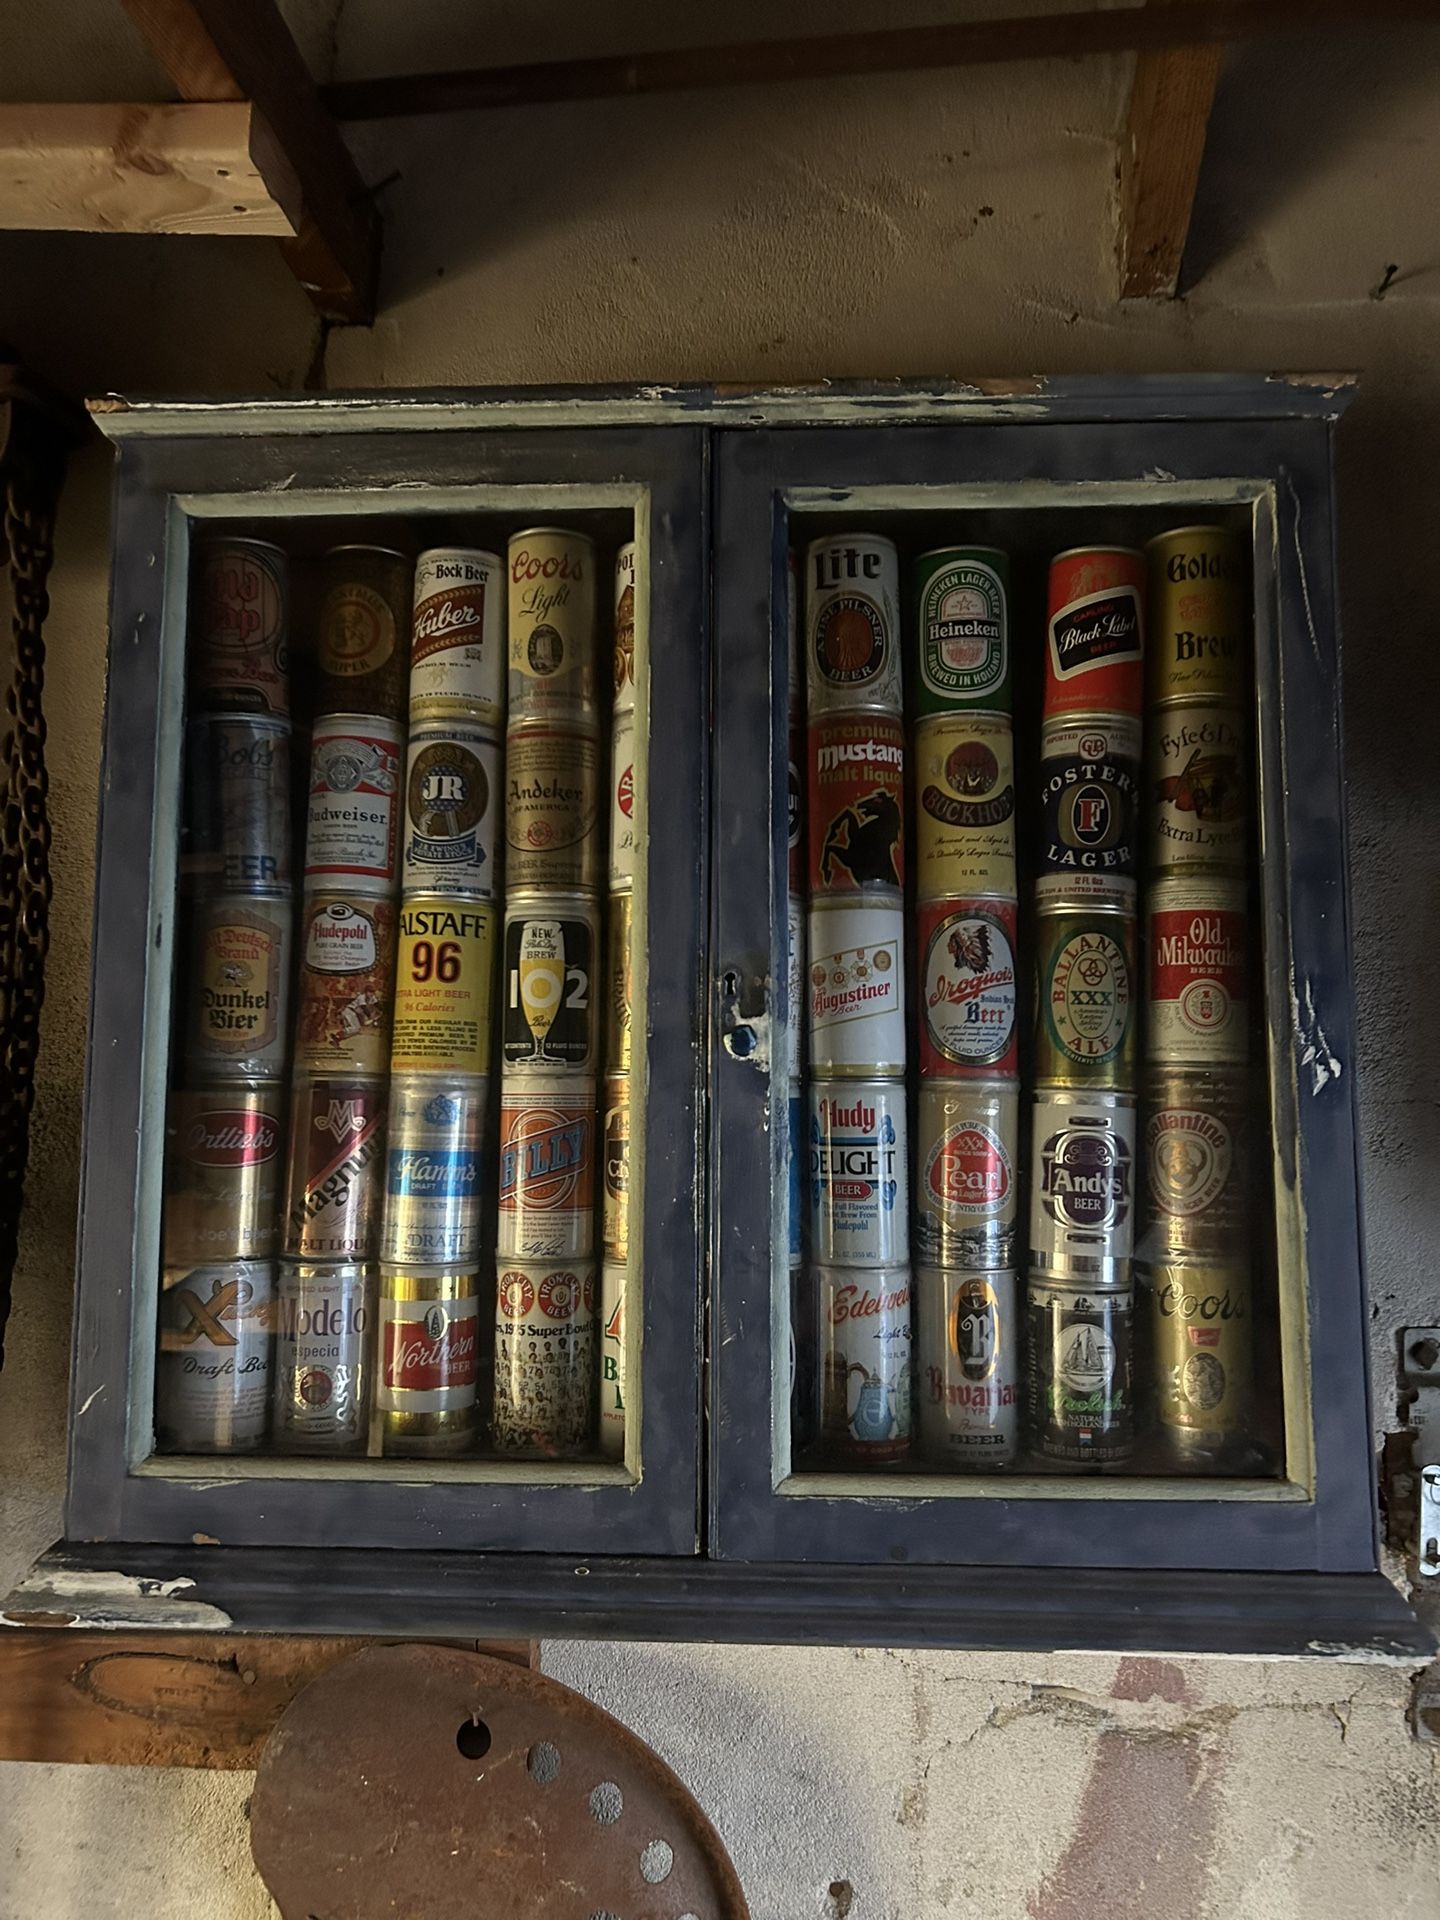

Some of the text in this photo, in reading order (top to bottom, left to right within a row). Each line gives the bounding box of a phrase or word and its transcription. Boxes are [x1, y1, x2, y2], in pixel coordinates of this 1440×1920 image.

[435, 564, 490, 583] Bock Beer
[512, 551, 583, 585] Coors
[815, 549, 881, 590] Lite
[520, 585, 571, 624] Light
[928, 575, 959, 618] HEINEKEN
[960, 572, 993, 593] LAGER
[412, 601, 482, 646] Huber
[839, 599, 883, 648] PILSNER
[929, 620, 1001, 641] Heineken
[1058, 613, 1137, 655] Black Label
[829, 664, 874, 682] BEER
[928, 651, 1001, 686] BREWED IN HOLLAND
[820, 722, 902, 746] premium
[1160, 726, 1198, 758] Fyfe
[818, 739, 903, 771] mustang
[818, 763, 904, 787] malt liquo
[421, 775, 465, 802] JR
[509, 779, 583, 803] Andeker
[924, 789, 1013, 825] BUCKHOR
[1077, 798, 1106, 832] F
[1157, 817, 1194, 842] Extra
[222, 855, 277, 881] EER
[1047, 844, 1131, 867] LAGER
[314, 922, 367, 942] Hudepohl
[531, 929, 554, 939] NEW
[1189, 917, 1226, 946] Old
[351, 942, 365, 950] BEER
[526, 951, 557, 961] BREW
[412, 941, 463, 984] 96
[1052, 935, 1128, 1004] BALLANTINE
[1189, 965, 1224, 975] BEER
[200, 986, 270, 1010] Dunkel
[416, 989, 472, 1000] LIGHT BEER
[813, 980, 891, 1018] Augustiner
[929, 965, 1014, 1008] Iroquois
[1070, 990, 1113, 1006] XXX
[208, 1009, 258, 1030] Bier
[415, 1003, 457, 1013] Calories
[965, 1000, 1007, 1023] Beer
[1066, 1036, 1114, 1055] ALE
[820, 1098, 876, 1134] Hudy
[189, 1123, 276, 1150] Ortlieb's
[395, 1156, 477, 1182] Hamm's
[502, 1127, 585, 1190] BILLY
[810, 1150, 897, 1176] DELIGHT
[940, 1154, 1003, 1192] Pearl
[834, 1184, 863, 1197] BEER
[1053, 1170, 1124, 1202] Andys
[840, 1210, 879, 1219] Brew From
[847, 1202, 880, 1216] Flavored
[1074, 1197, 1102, 1212] BEER
[408, 1233, 467, 1247] DRAFT
[501, 1272, 534, 1299] IRON CITY
[539, 1272, 565, 1299] IRON
[547, 1304, 576, 1318] BEER
[828, 1283, 913, 1325] Edelwei
[279, 1297, 367, 1342] Modelo
[504, 1322, 526, 1336] 195
[526, 1322, 565, 1339] Super
[291, 1344, 341, 1361] especia
[387, 1334, 475, 1373] Northern
[182, 1357, 236, 1380] Draft
[446, 1360, 471, 1376] BEER
[949, 1433, 1005, 1446] BEER
